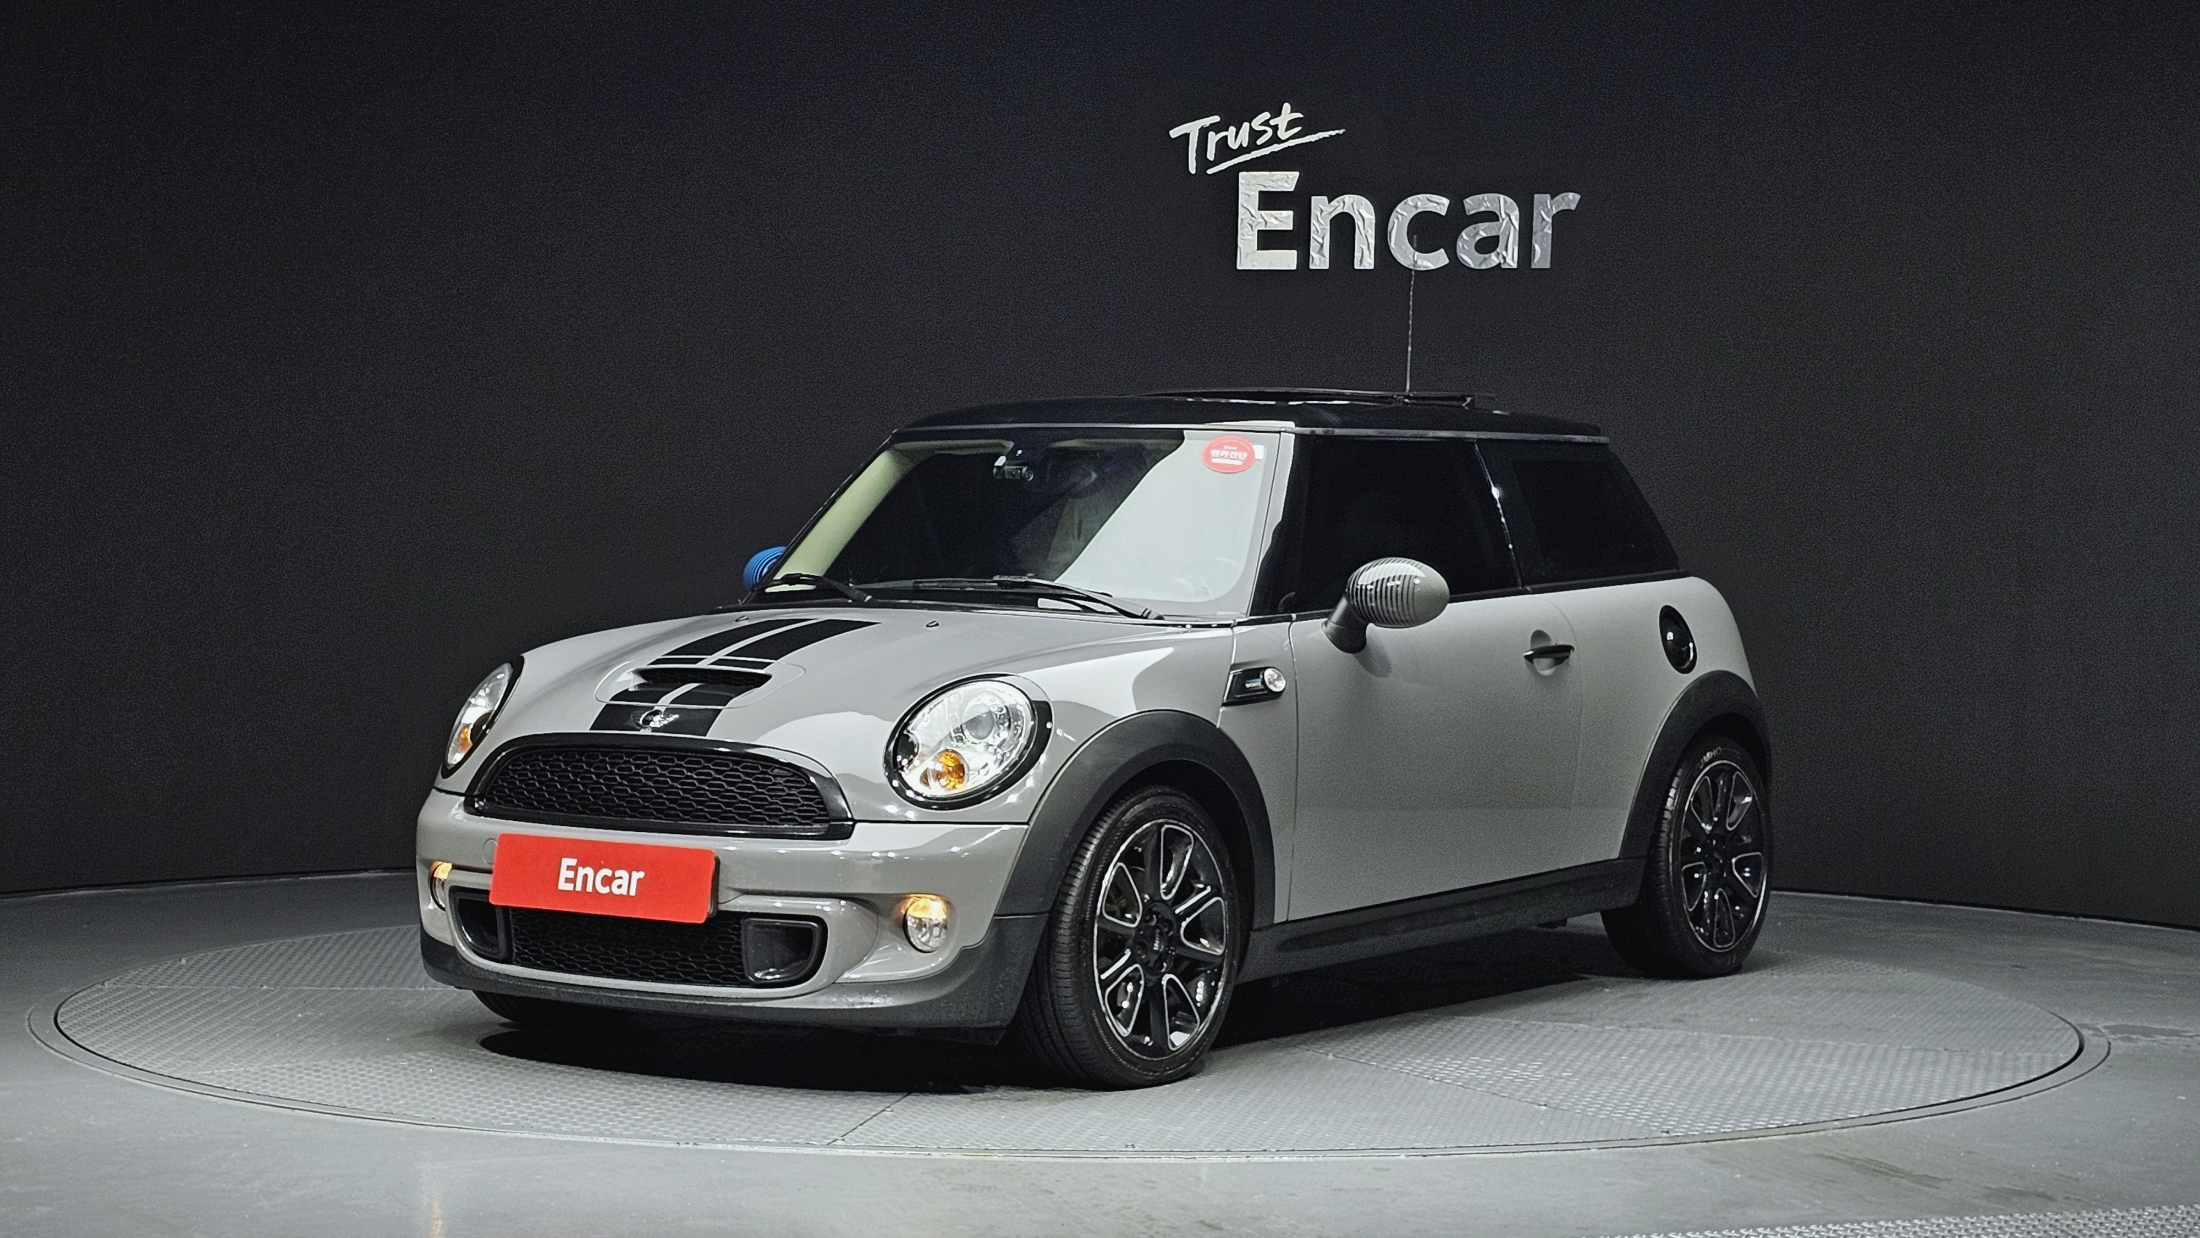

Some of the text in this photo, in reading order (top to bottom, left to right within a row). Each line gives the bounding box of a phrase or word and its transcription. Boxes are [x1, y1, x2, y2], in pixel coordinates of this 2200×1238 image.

[1168, 102, 1305, 175] Trust
[1236, 170, 1582, 271] Encar
[557, 857, 646, 897] Encar
